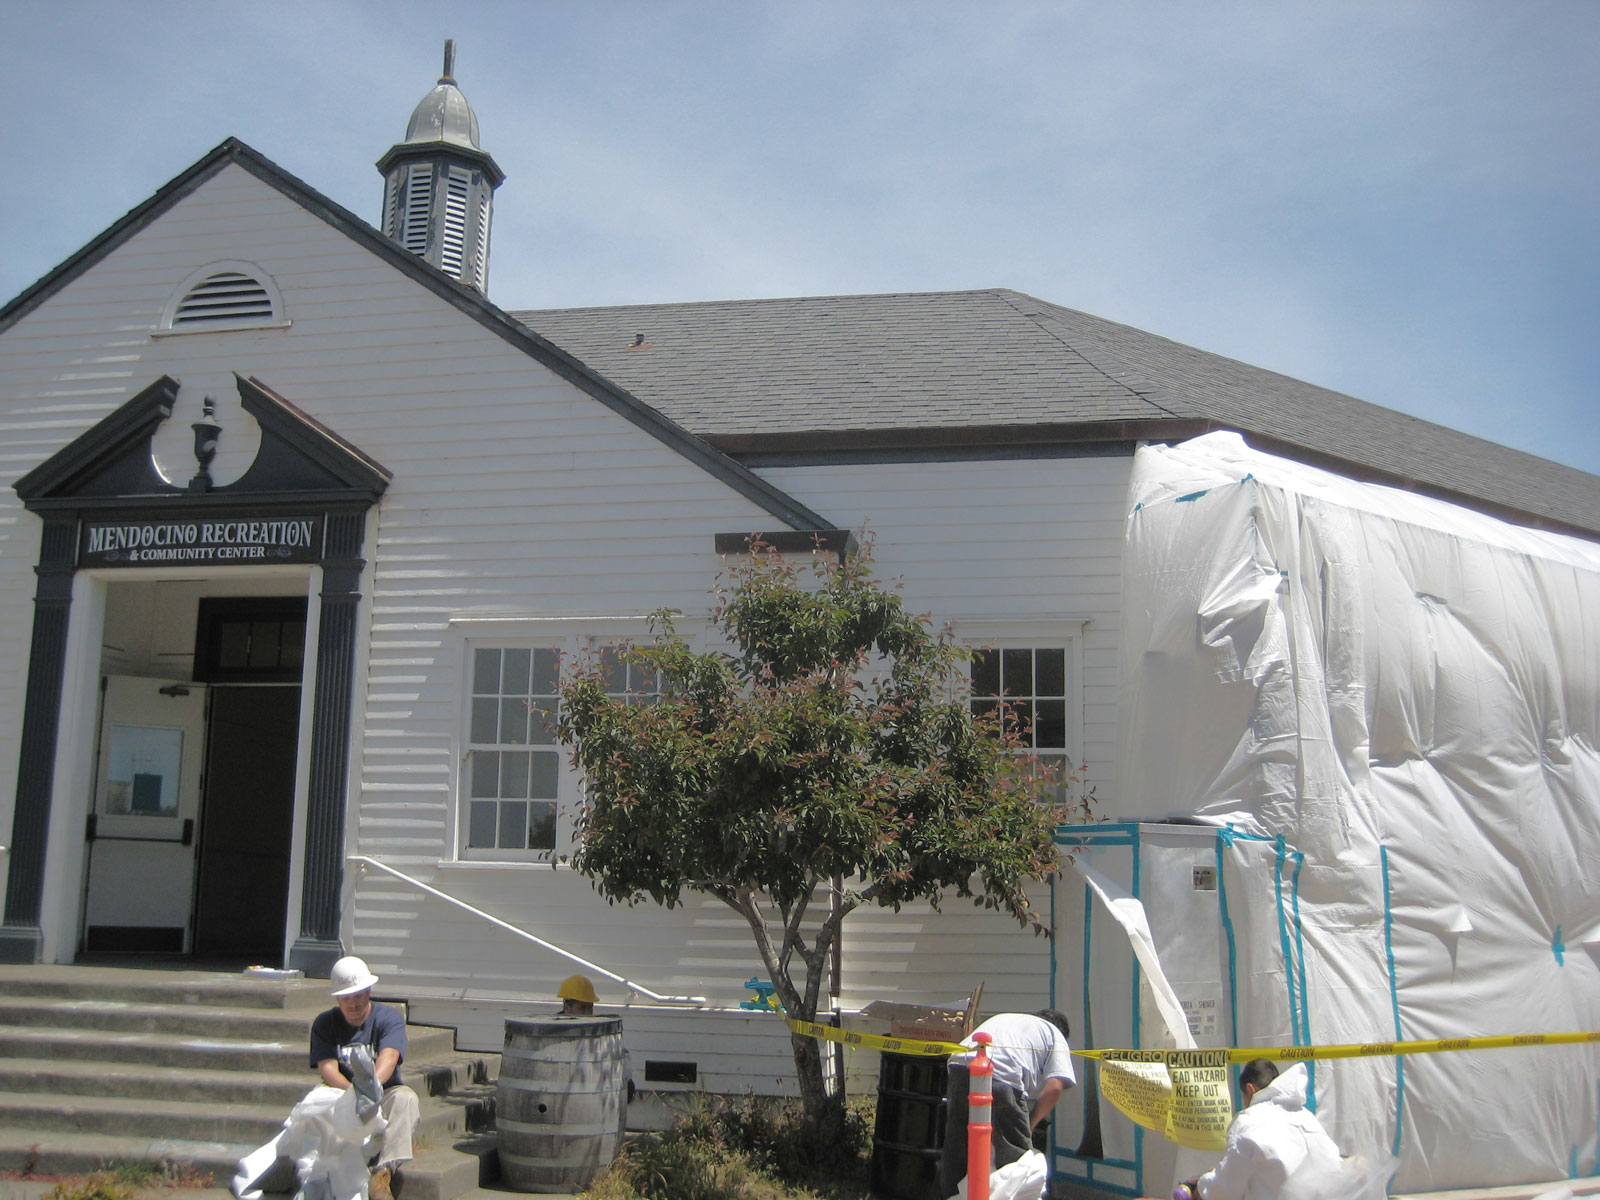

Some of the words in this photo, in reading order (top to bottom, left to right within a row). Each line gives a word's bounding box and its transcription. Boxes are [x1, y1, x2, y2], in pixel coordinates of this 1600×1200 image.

[88, 523, 198, 553] MENDOCINO
[200, 521, 313, 547] RECREATION
[129, 550, 139, 561] &
[141, 547, 216, 560] COMMUNITY
[217, 546, 265, 558] CENTER
[1102, 1051, 1163, 1062] PELIGRO
[1280, 1048, 1315, 1059] CAUTION
[1360, 1044, 1393, 1054] CAUTION
[1437, 1040, 1470, 1049] CAUTION
[1168, 1051, 1224, 1067] CAUTION
[1172, 1071, 1190, 1083] EAD
[1193, 1070, 1225, 1082] HAZARD
[1176, 1085, 1199, 1097] KEEP
[1203, 1084, 1218, 1097] OUT
